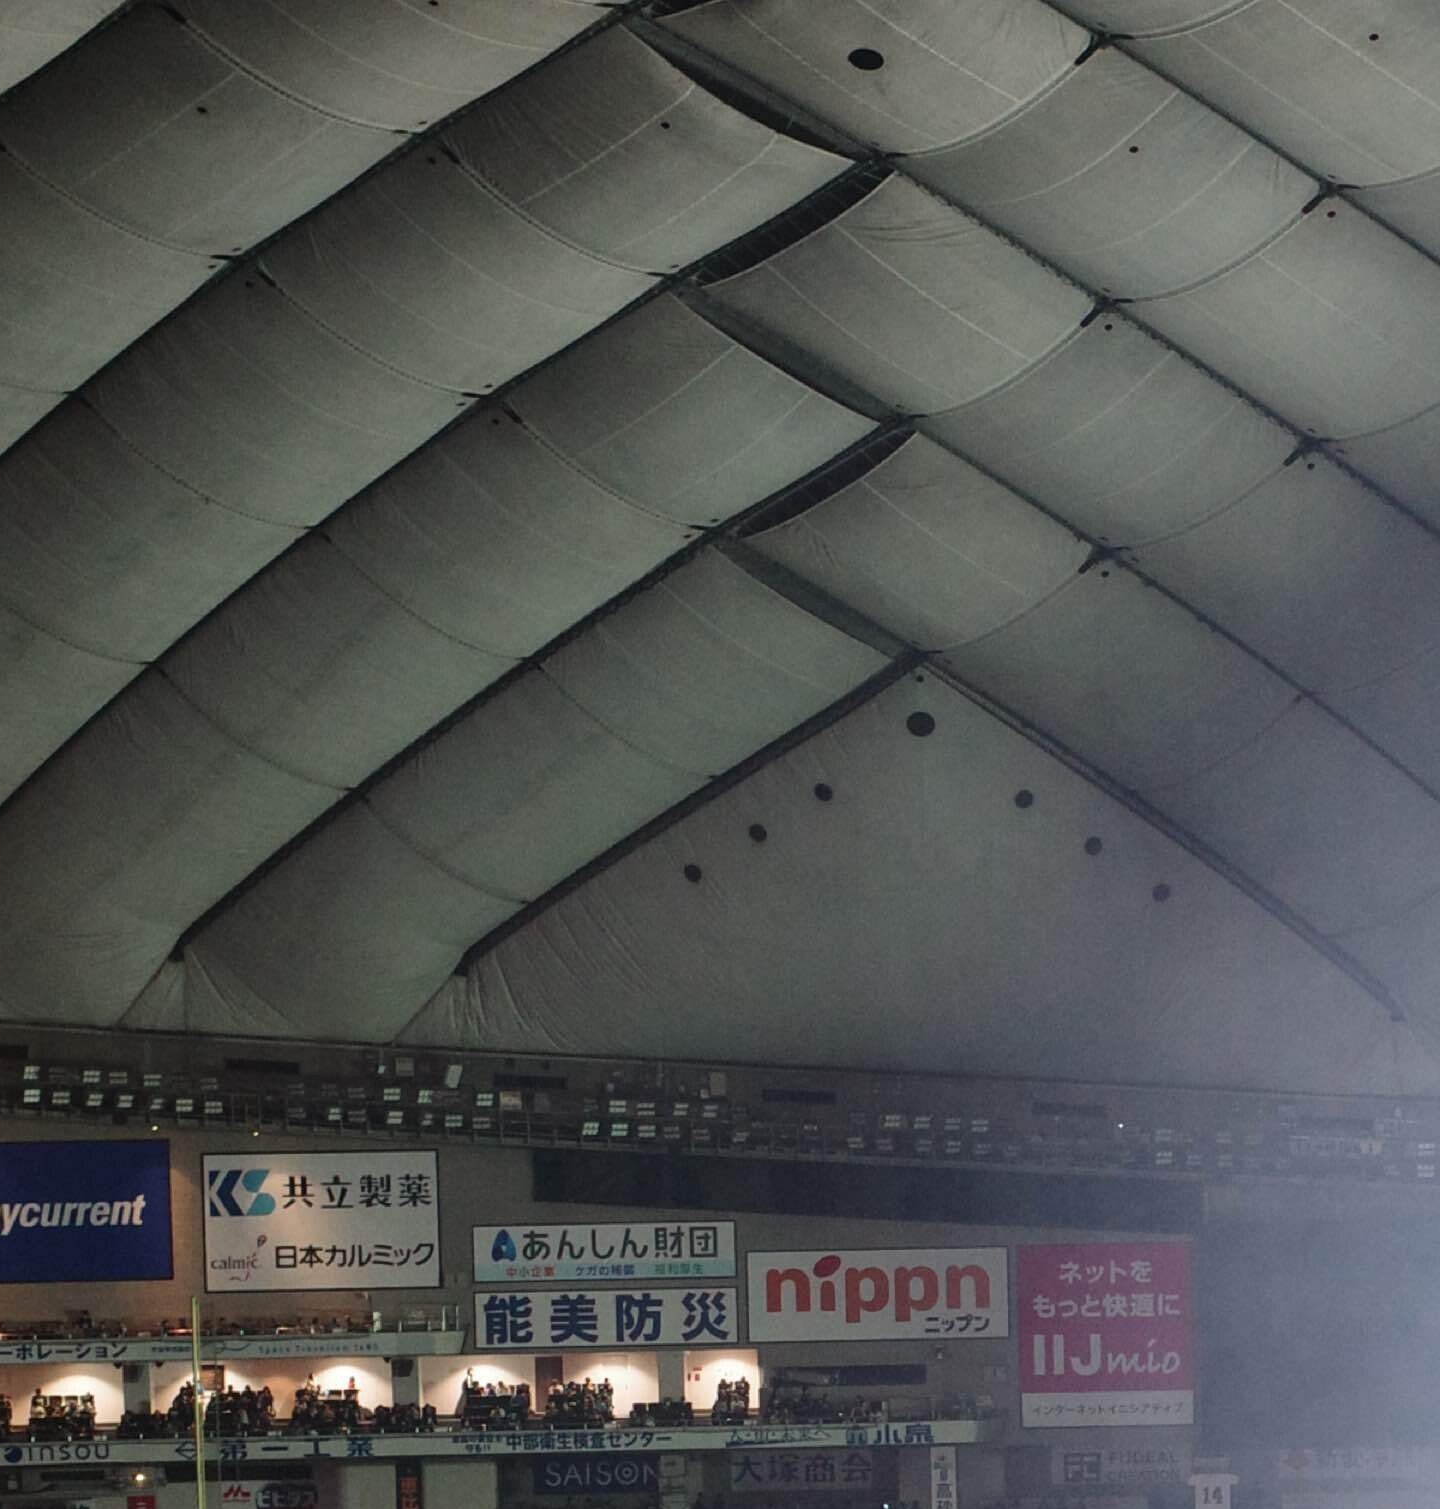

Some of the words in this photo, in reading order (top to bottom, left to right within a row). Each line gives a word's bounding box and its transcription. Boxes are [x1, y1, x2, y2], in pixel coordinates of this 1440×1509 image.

[282, 1174, 432, 1208] 共立製薬
[275, 1243, 434, 1269] 日本カルミック
[522, 1226, 718, 1260] あんしん財団
[210, 1253, 259, 1270] calmic
[1058, 1259, 1153, 1284] ネットを
[766, 1254, 991, 1323] nippn
[484, 1292, 729, 1345] 能美防災
[1032, 1293, 1181, 1318] もっと快適に
[924, 1314, 991, 1334] ニップン
[734, 1455, 872, 1483] 大塚商会
